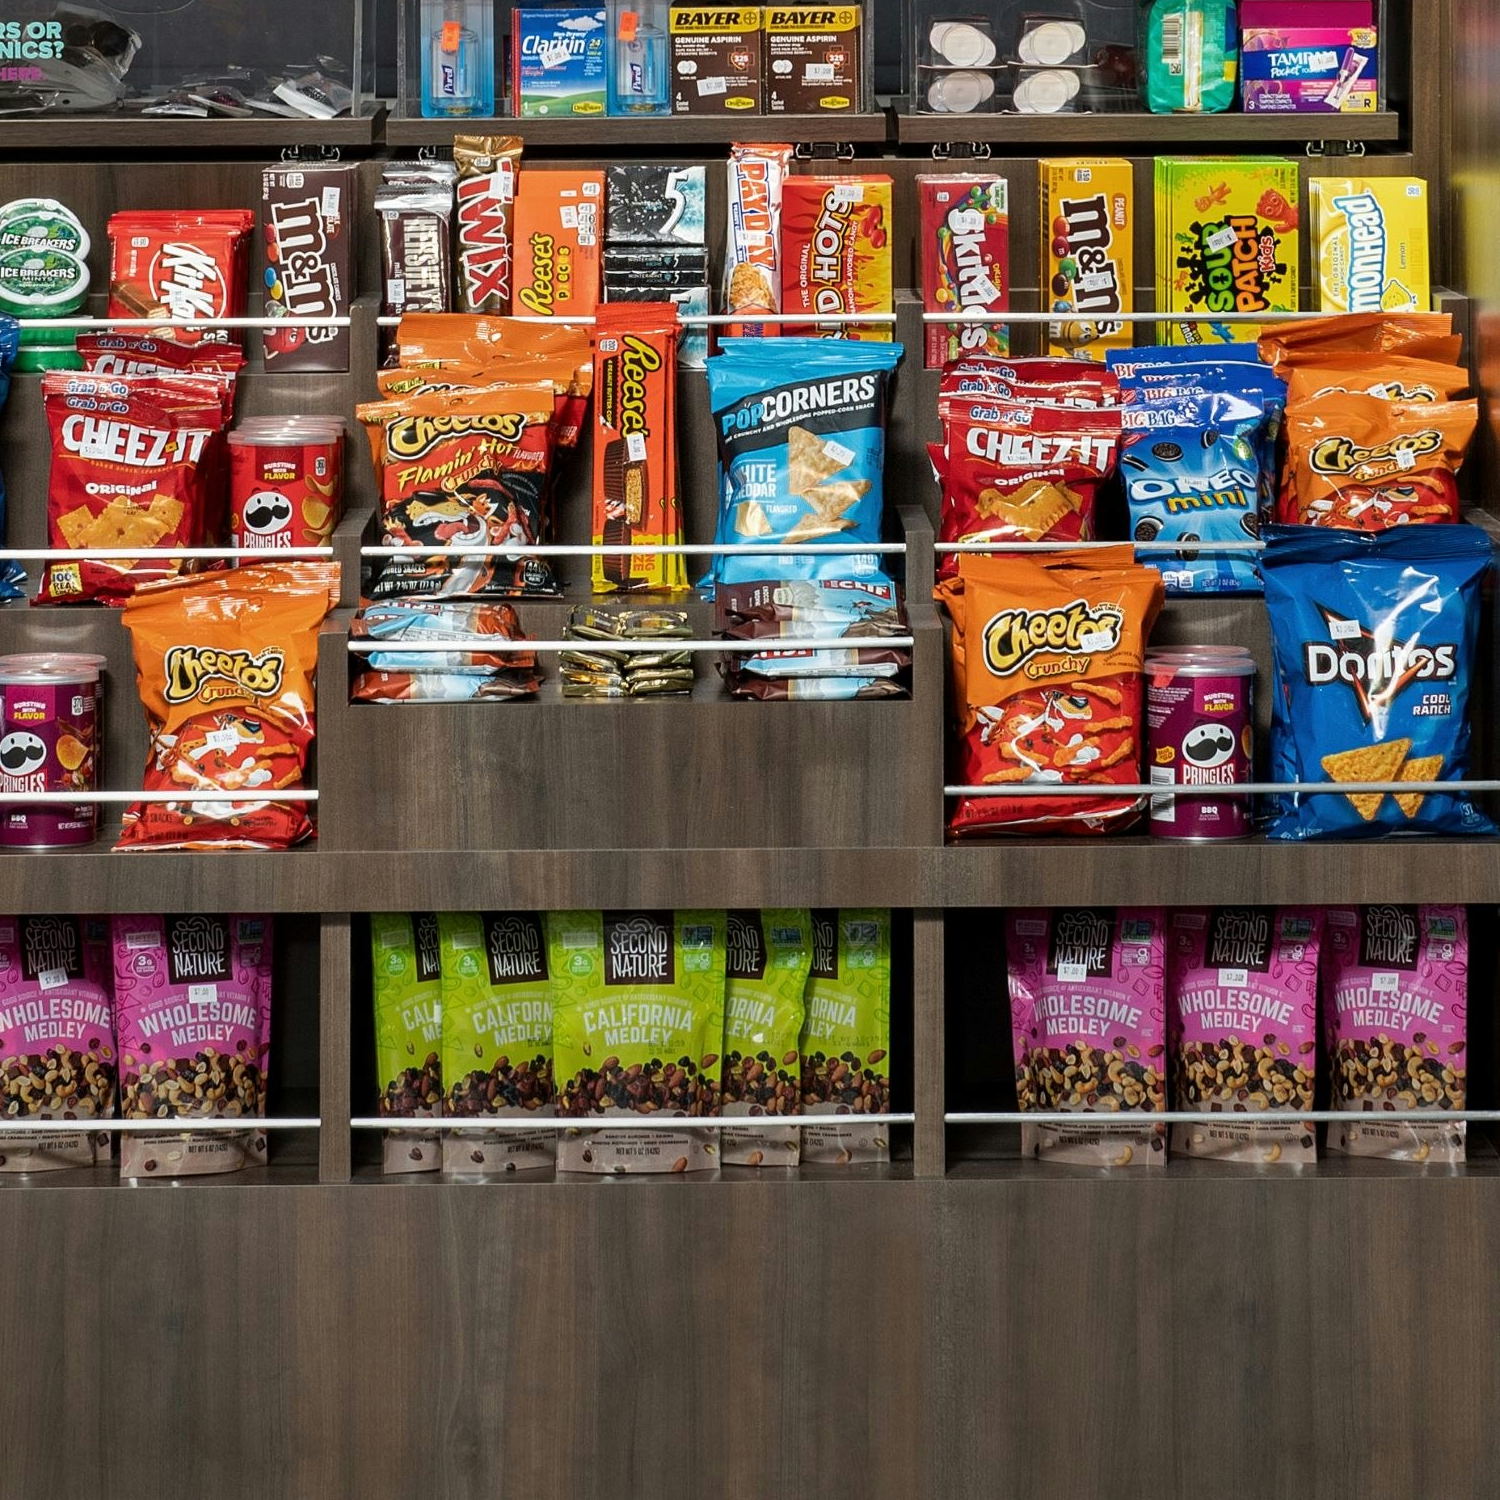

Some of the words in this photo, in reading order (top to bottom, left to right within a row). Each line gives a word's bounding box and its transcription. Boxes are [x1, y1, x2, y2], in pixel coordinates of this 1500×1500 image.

[675, 13, 741, 25] BAYER
[771, 12, 836, 25] BAYER
[27, 21, 62, 40] OR
[675, 36, 709, 44] GENUINE
[770, 35, 805, 43] GENUINE
[806, 35, 837, 43] ASPIRIN
[522, 35, 585, 54] Claritin
[1113, 197, 1126, 226] PEANUT
[0, 232, 22, 246] ICE
[21, 235, 77, 250] BREAKERS
[0, 267, 18, 278] ICE
[19, 267, 76, 279] BREAKERS
[519, 232, 555, 316] Reese's
[801, 242, 811, 288] ORIGINAL
[1230, 215, 1266, 313] PATCH
[1256, 235, 1277, 273] Kids
[802, 289, 810, 308] THE
[67, 396, 96, 410] Grab
[110, 402, 129, 413] Go
[722, 374, 876, 436] POPCORNERS
[969, 406, 998, 421] Grab
[1147, 410, 1175, 426] BAG
[85, 480, 158, 496] ORIGINAL
[263, 472, 296, 481] FLAVOR
[994, 468, 1065, 486] ORIGINAL
[1167, 485, 1247, 515] mini
[243, 530, 292, 549] PRINGLES
[986, 603, 1122, 676] Cheetos
[164, 646, 285, 703] Cheetos
[1023, 655, 1091, 680] Crunchy
[1308, 645, 1456, 683] Doritos
[1203, 702, 1235, 711] FLAVOR
[1411, 704, 1452, 716] RANCH
[1422, 694, 1451, 705] COOL
[13, 711, 45, 721] FLAVOR
[1183, 764, 1234, 786] PRINGLES
[1200, 806, 1218, 815] BBQ
[172, 922, 225, 953] SECOND
[489, 926, 540, 957] SECOND
[610, 926, 668, 955] SECOND
[1212, 916, 1269, 945] SECOND
[1211, 937, 1265, 966] NATURE
[174, 950, 225, 978] NATURE
[492, 950, 541, 977] NATURE
[611, 950, 669, 979] NATURE
[583, 1002, 694, 1034] CALIFORNIA
[1178, 989, 1295, 1024] WHOLESOME
[137, 998, 257, 1039] WHOLESOME
[1200, 1010, 1263, 1033] MEDLEY
[23, 1019, 86, 1043] MEDLEY
[171, 1022, 233, 1048] MEDLEY
[604, 1024, 673, 1047] MEDLEY
